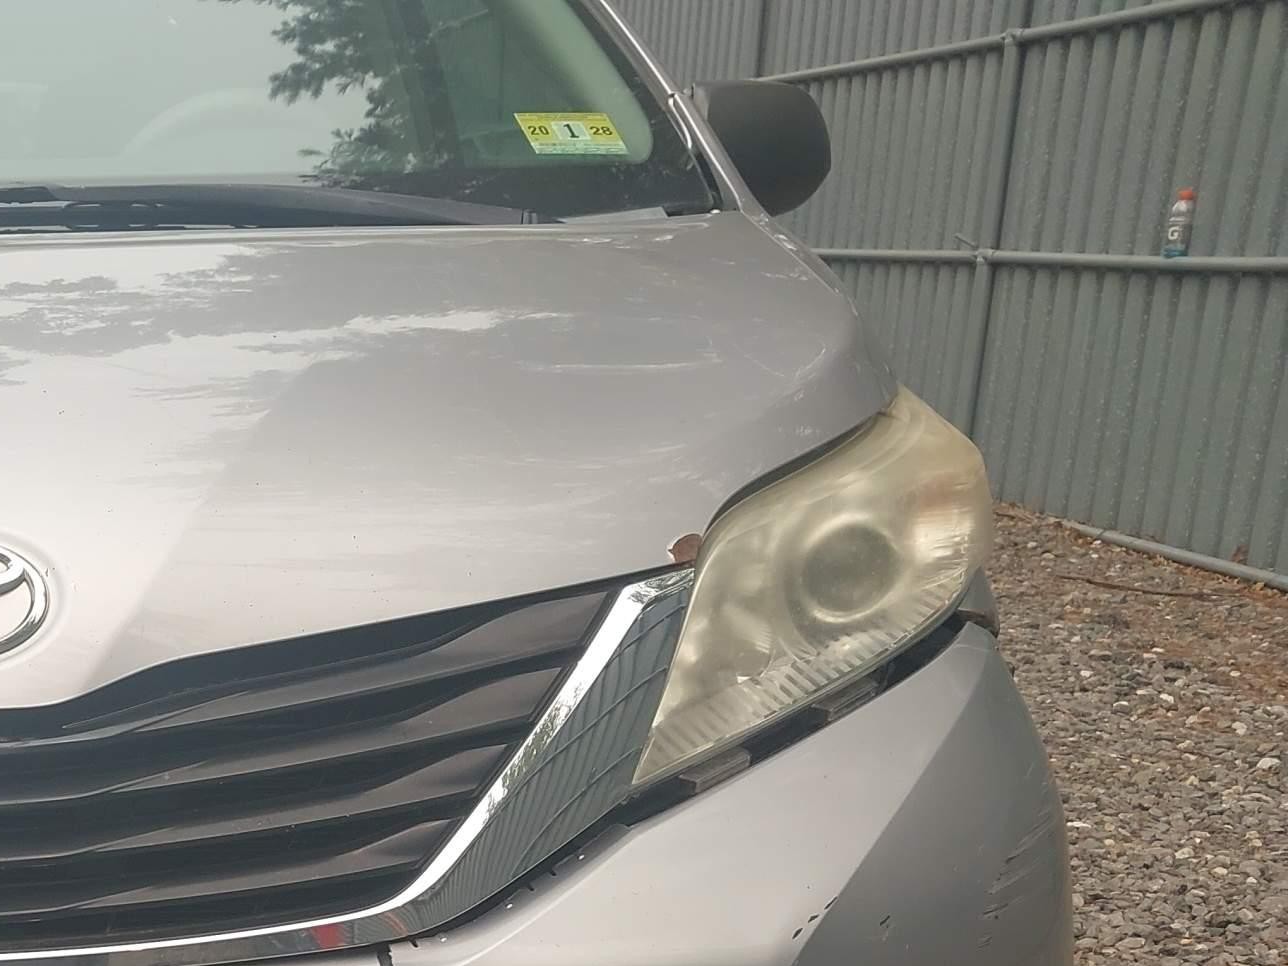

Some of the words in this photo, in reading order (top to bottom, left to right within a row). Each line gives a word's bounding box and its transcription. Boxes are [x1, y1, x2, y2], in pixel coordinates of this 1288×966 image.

[527, 125, 550, 136] 20
[563, 123, 580, 139] 1
[589, 125, 614, 137] 28
[1167, 225, 1180, 241] G
